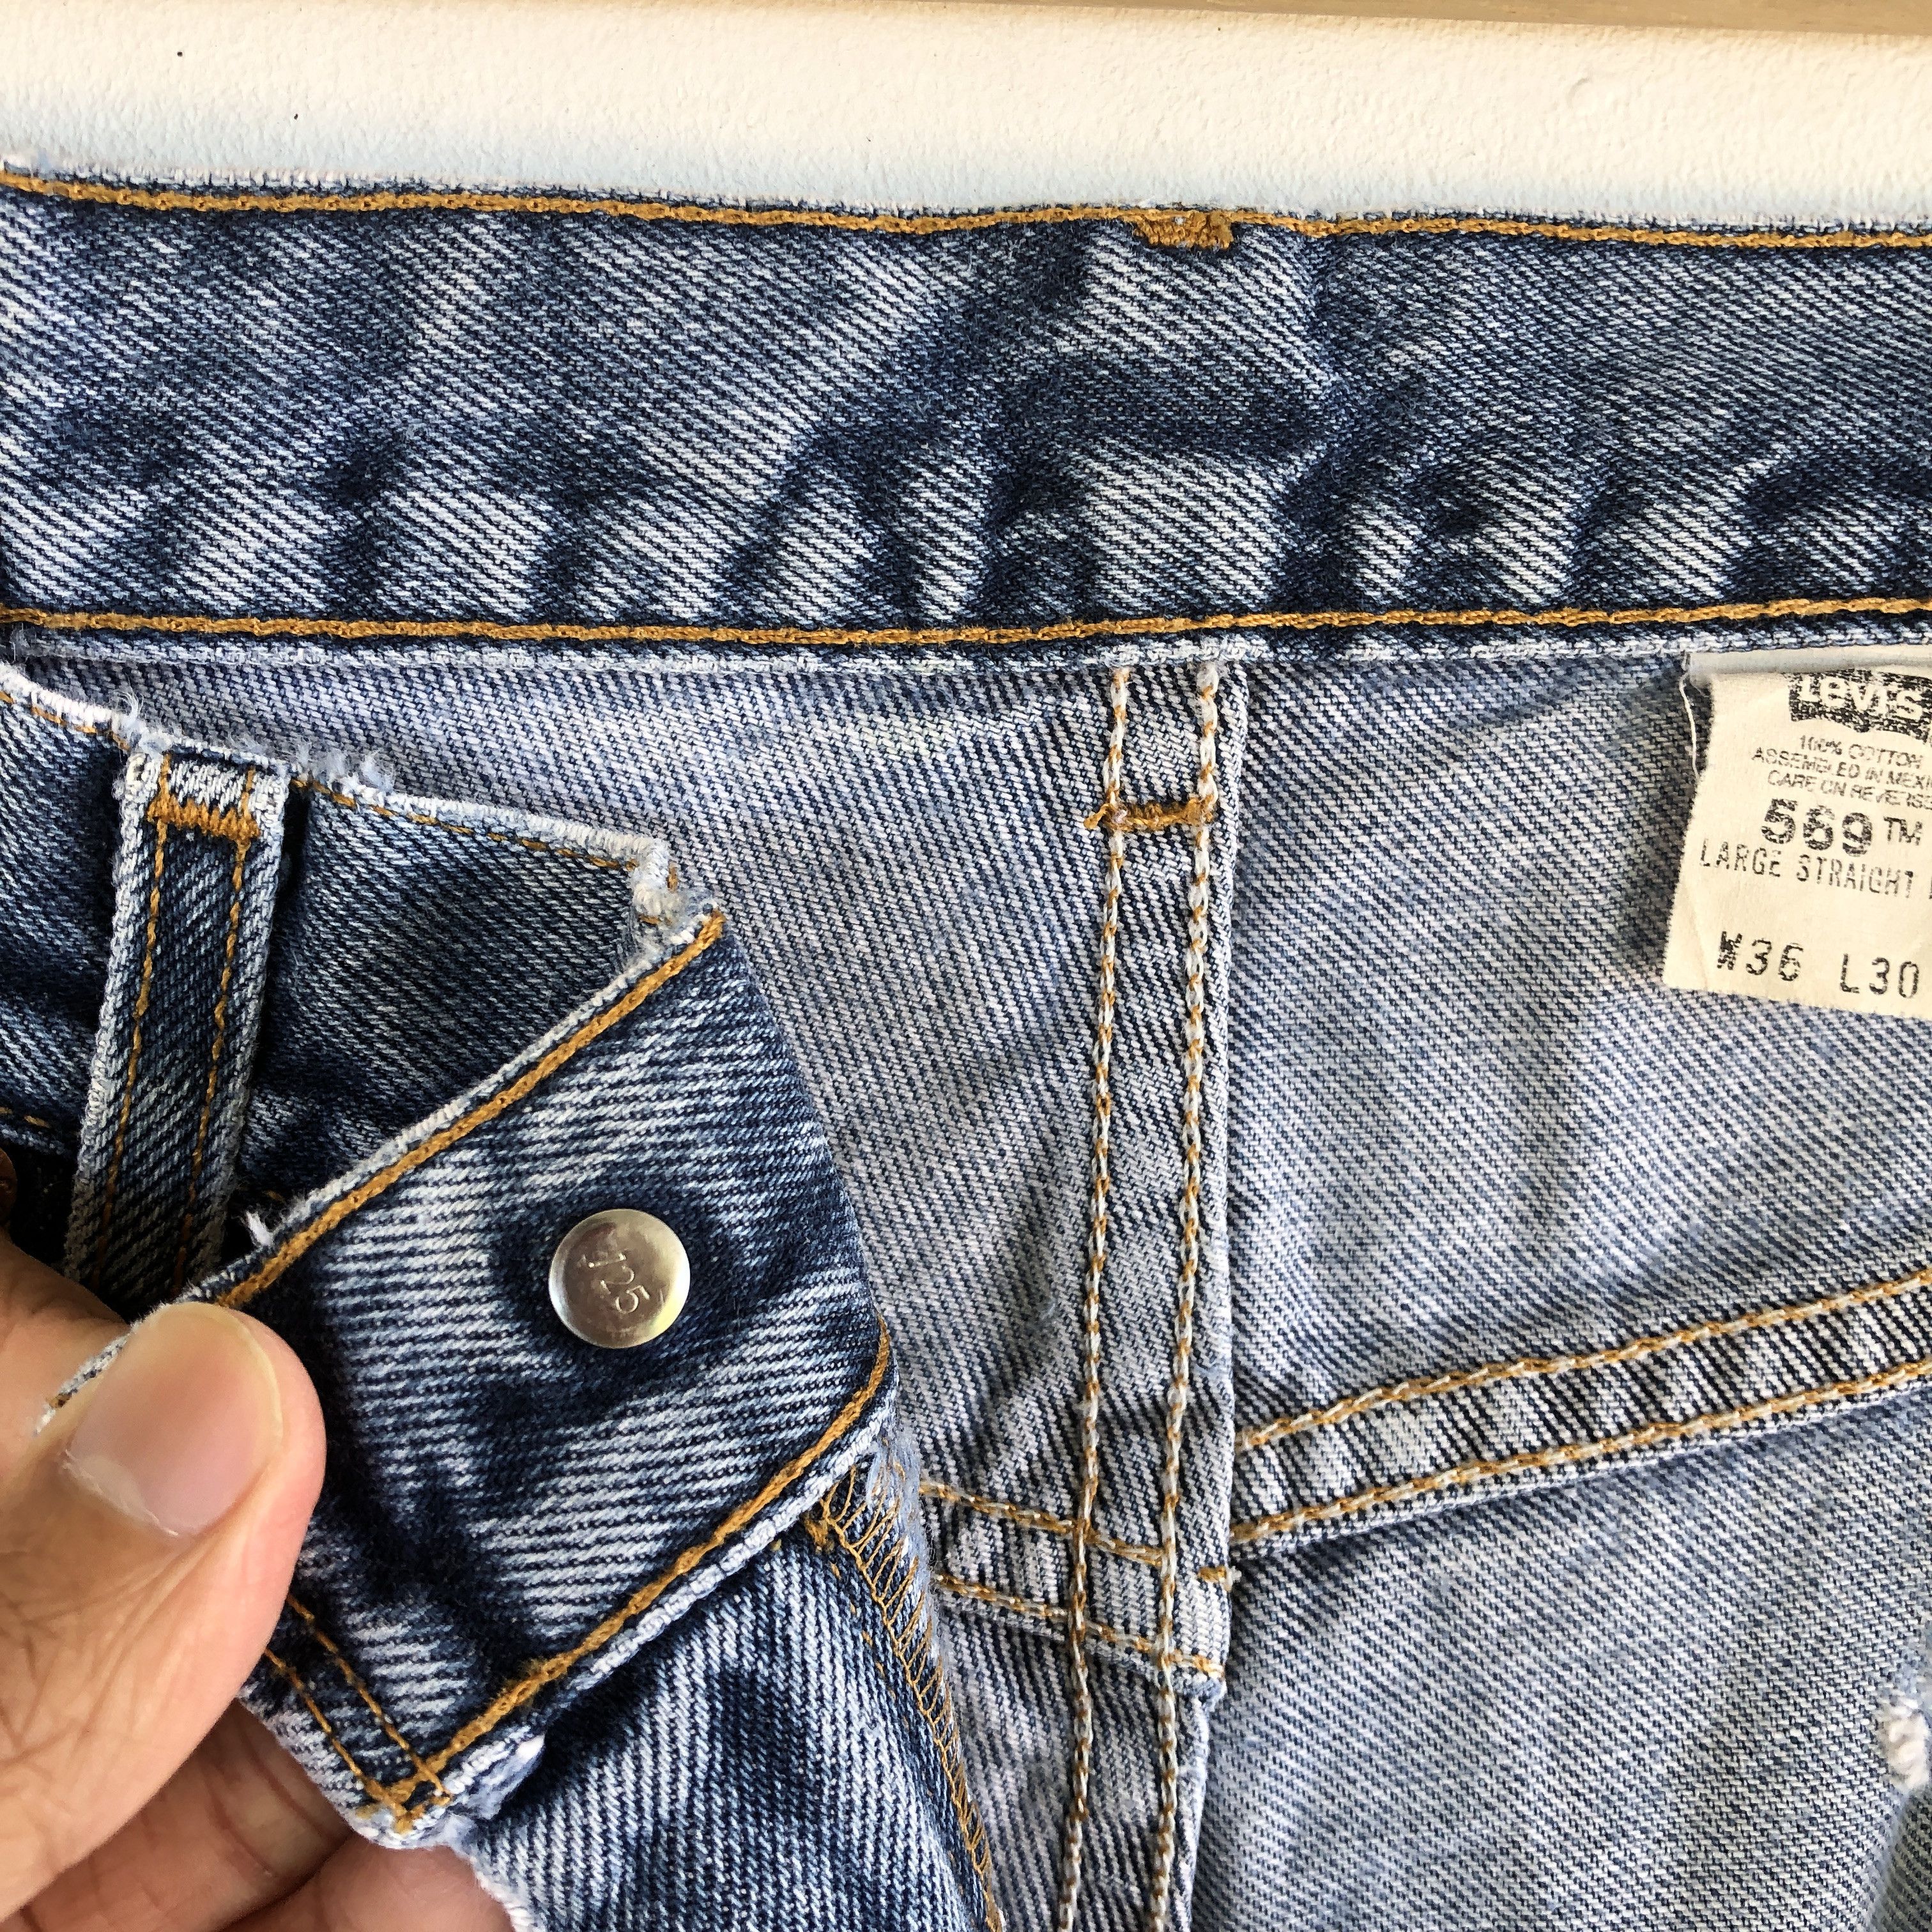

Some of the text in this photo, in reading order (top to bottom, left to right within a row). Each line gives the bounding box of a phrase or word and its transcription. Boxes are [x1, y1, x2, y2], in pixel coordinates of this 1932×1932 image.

[1751, 746, 1861, 779] ASSEMBLED
[1886, 770, 1932, 790] MEXI
[1848, 744, 1924, 769] COTTON
[1768, 770, 1818, 792] CARE
[1821, 779, 1847, 797] ON
[1699, 838, 1782, 877] LARGE
[1796, 854, 1913, 898] STRAIGHT
[1717, 931, 1917, 998] W36 L30
